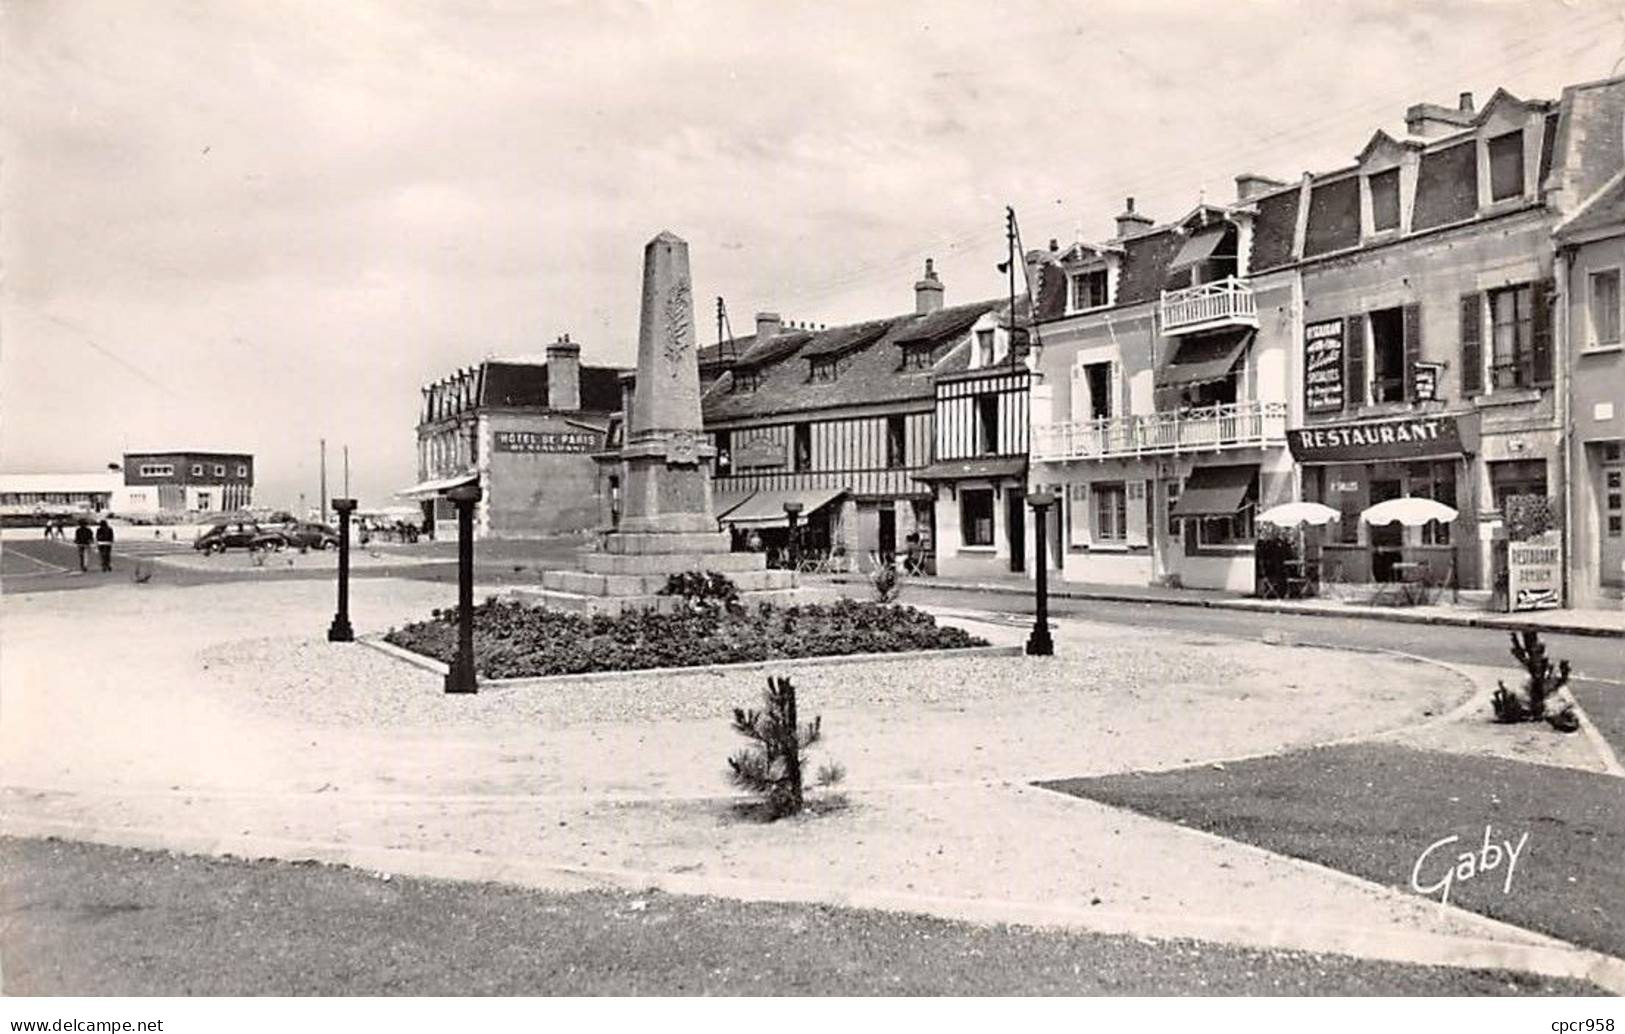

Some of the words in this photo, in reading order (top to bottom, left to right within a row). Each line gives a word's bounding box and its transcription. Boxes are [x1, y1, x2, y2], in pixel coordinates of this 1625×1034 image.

[541, 434, 555, 444] DE
[561, 434, 595, 445] PARIS
[1301, 422, 1438, 448] RESTAURANT
